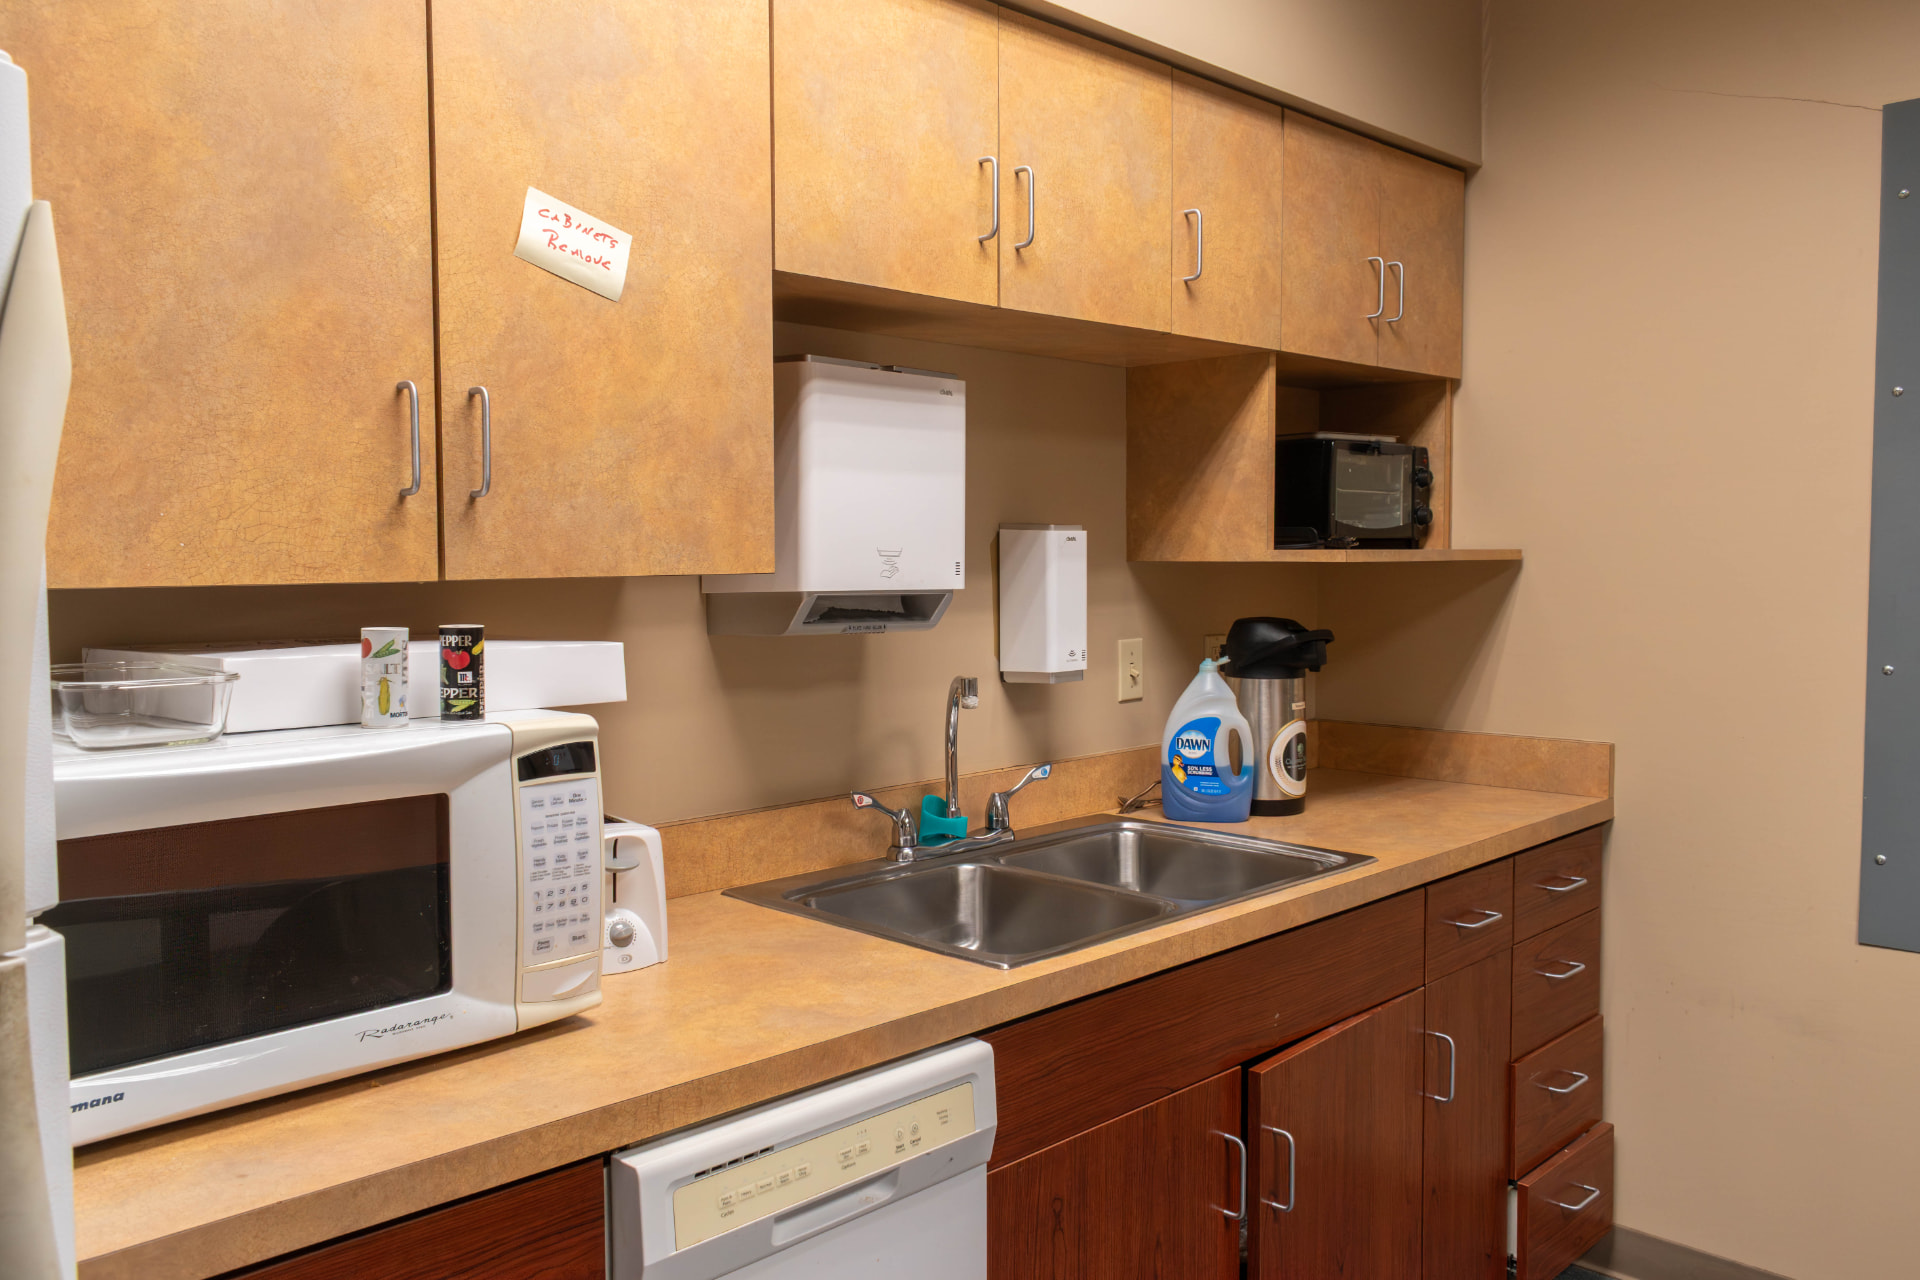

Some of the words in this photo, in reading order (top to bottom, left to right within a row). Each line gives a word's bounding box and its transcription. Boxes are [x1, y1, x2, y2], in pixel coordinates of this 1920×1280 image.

[538, 208, 619, 249] CABINETS
[1176, 738, 1211, 752] DAWN
[354, 1013, 452, 1043] Radarange
